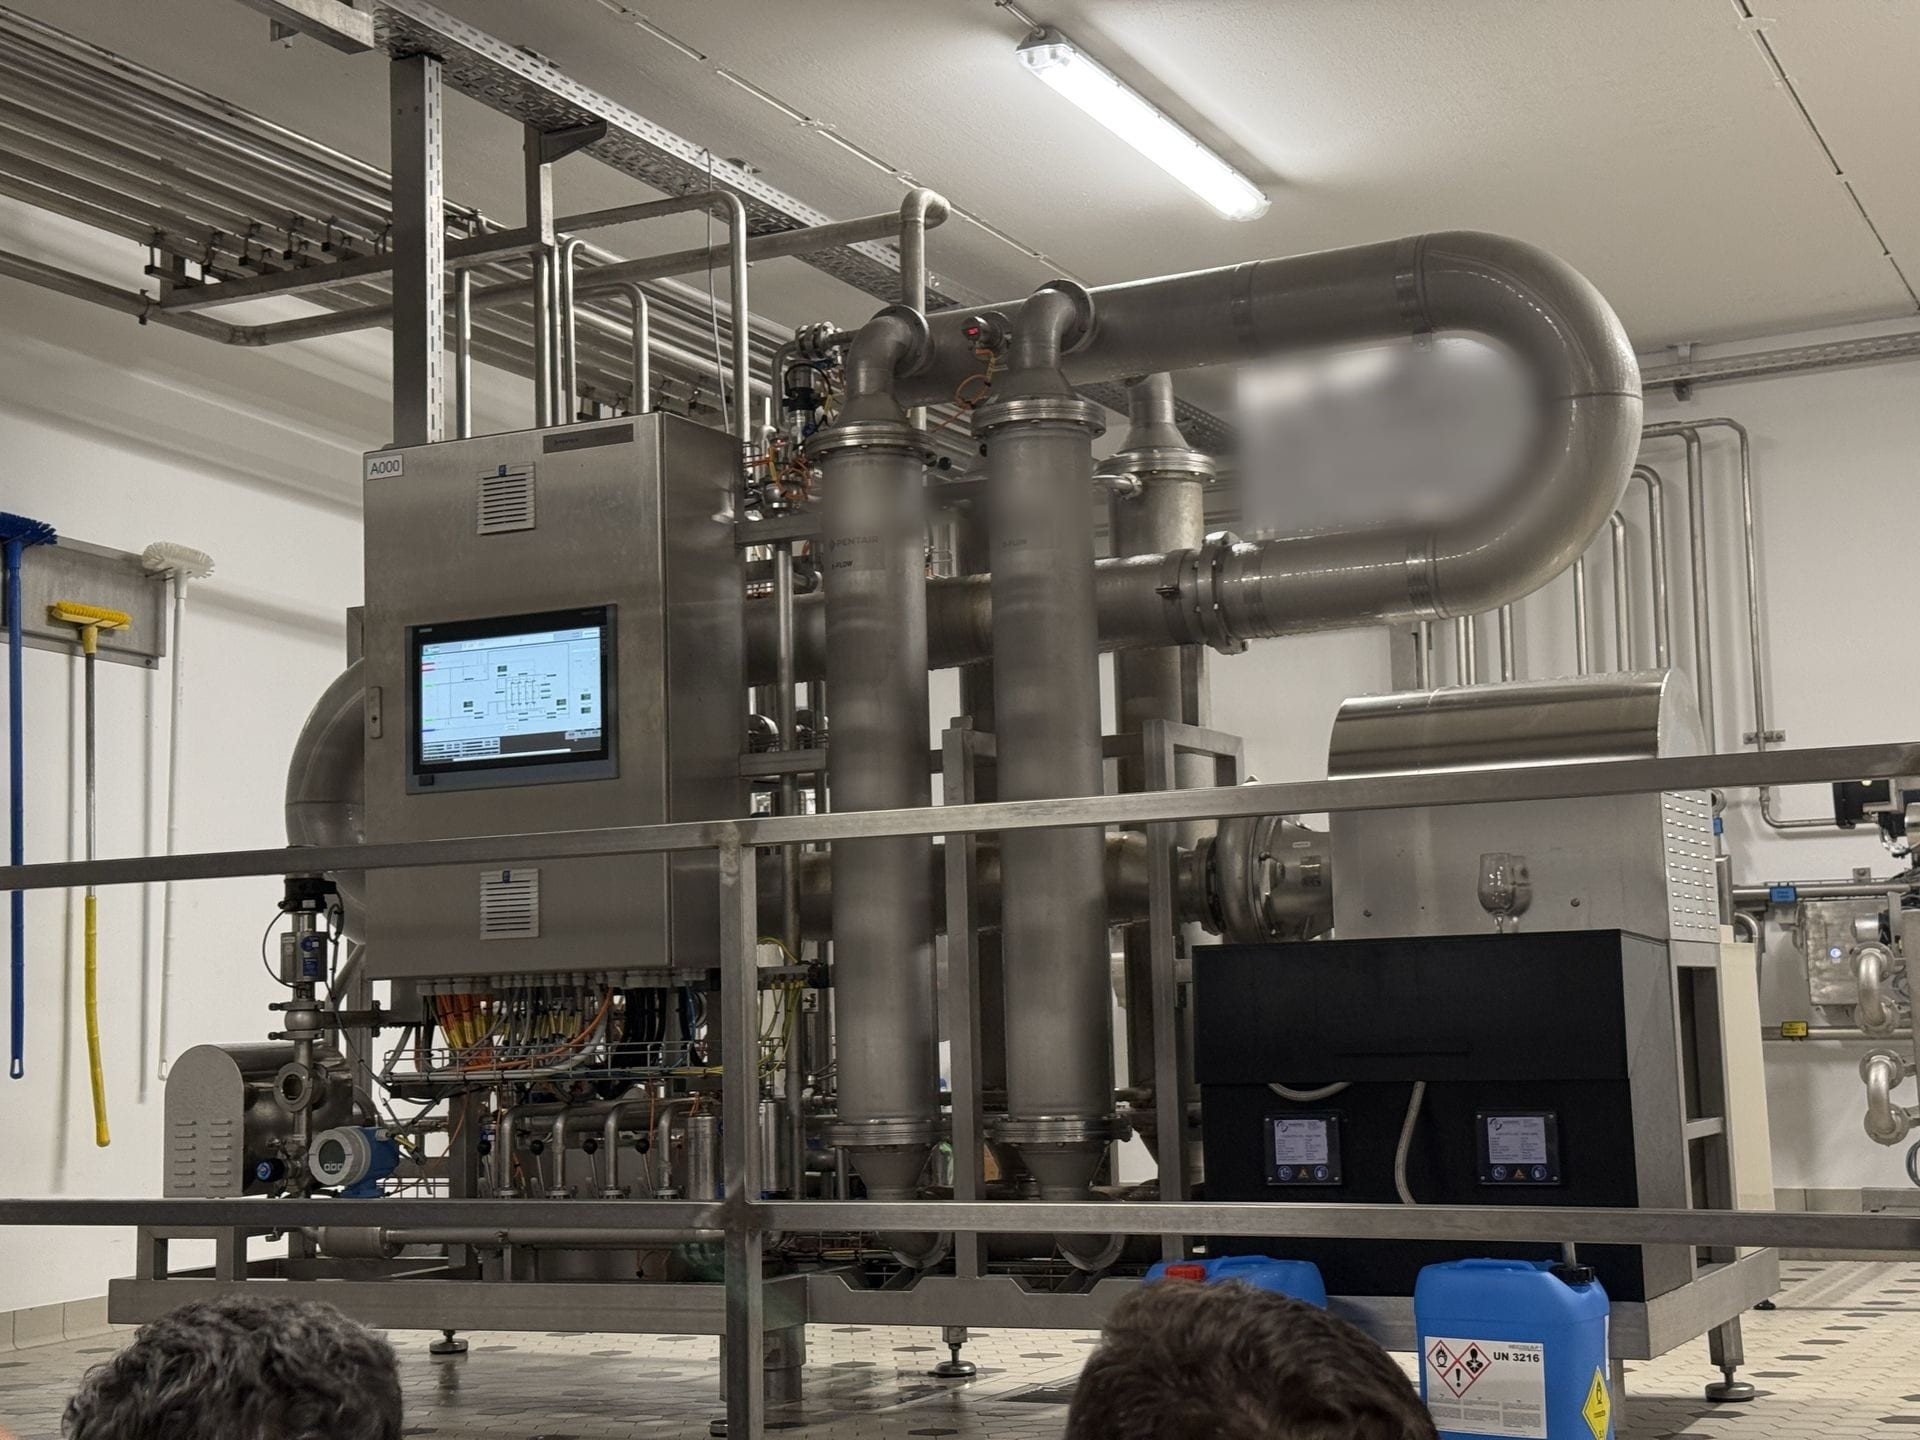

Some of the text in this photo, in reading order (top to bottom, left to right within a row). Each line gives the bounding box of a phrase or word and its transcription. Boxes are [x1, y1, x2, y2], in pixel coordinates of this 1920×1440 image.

[370, 459, 400, 475] A000
[836, 535, 879, 547] PENTAIR
[1493, 1351, 1540, 1363] UN 3216
